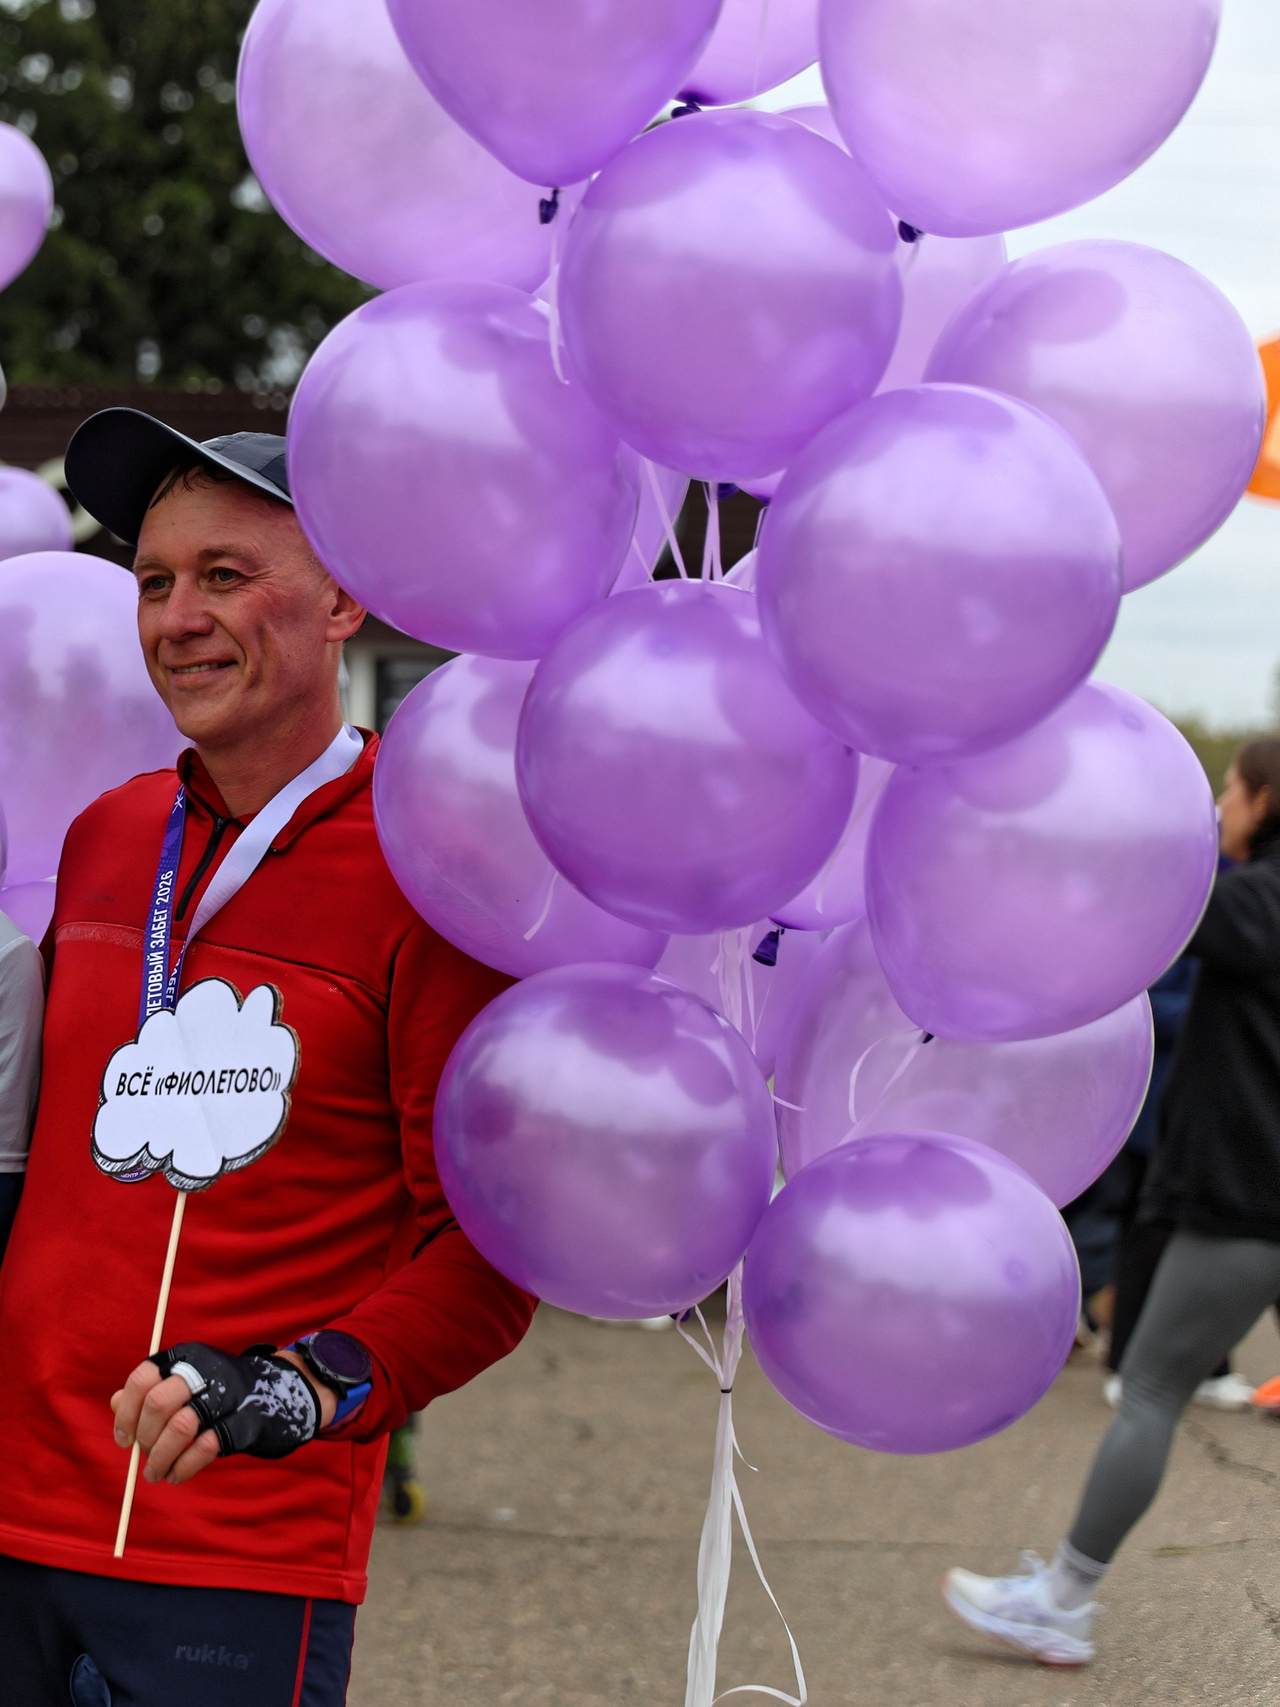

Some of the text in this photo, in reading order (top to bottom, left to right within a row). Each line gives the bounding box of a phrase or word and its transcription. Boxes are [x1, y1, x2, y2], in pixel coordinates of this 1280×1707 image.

[146, 870, 174, 1017] ЛЕТОВЫЙ ЗАБЕГ 2026
[115, 1066, 281, 1096] ВСЁ «ФИОЛЕТОВО»
